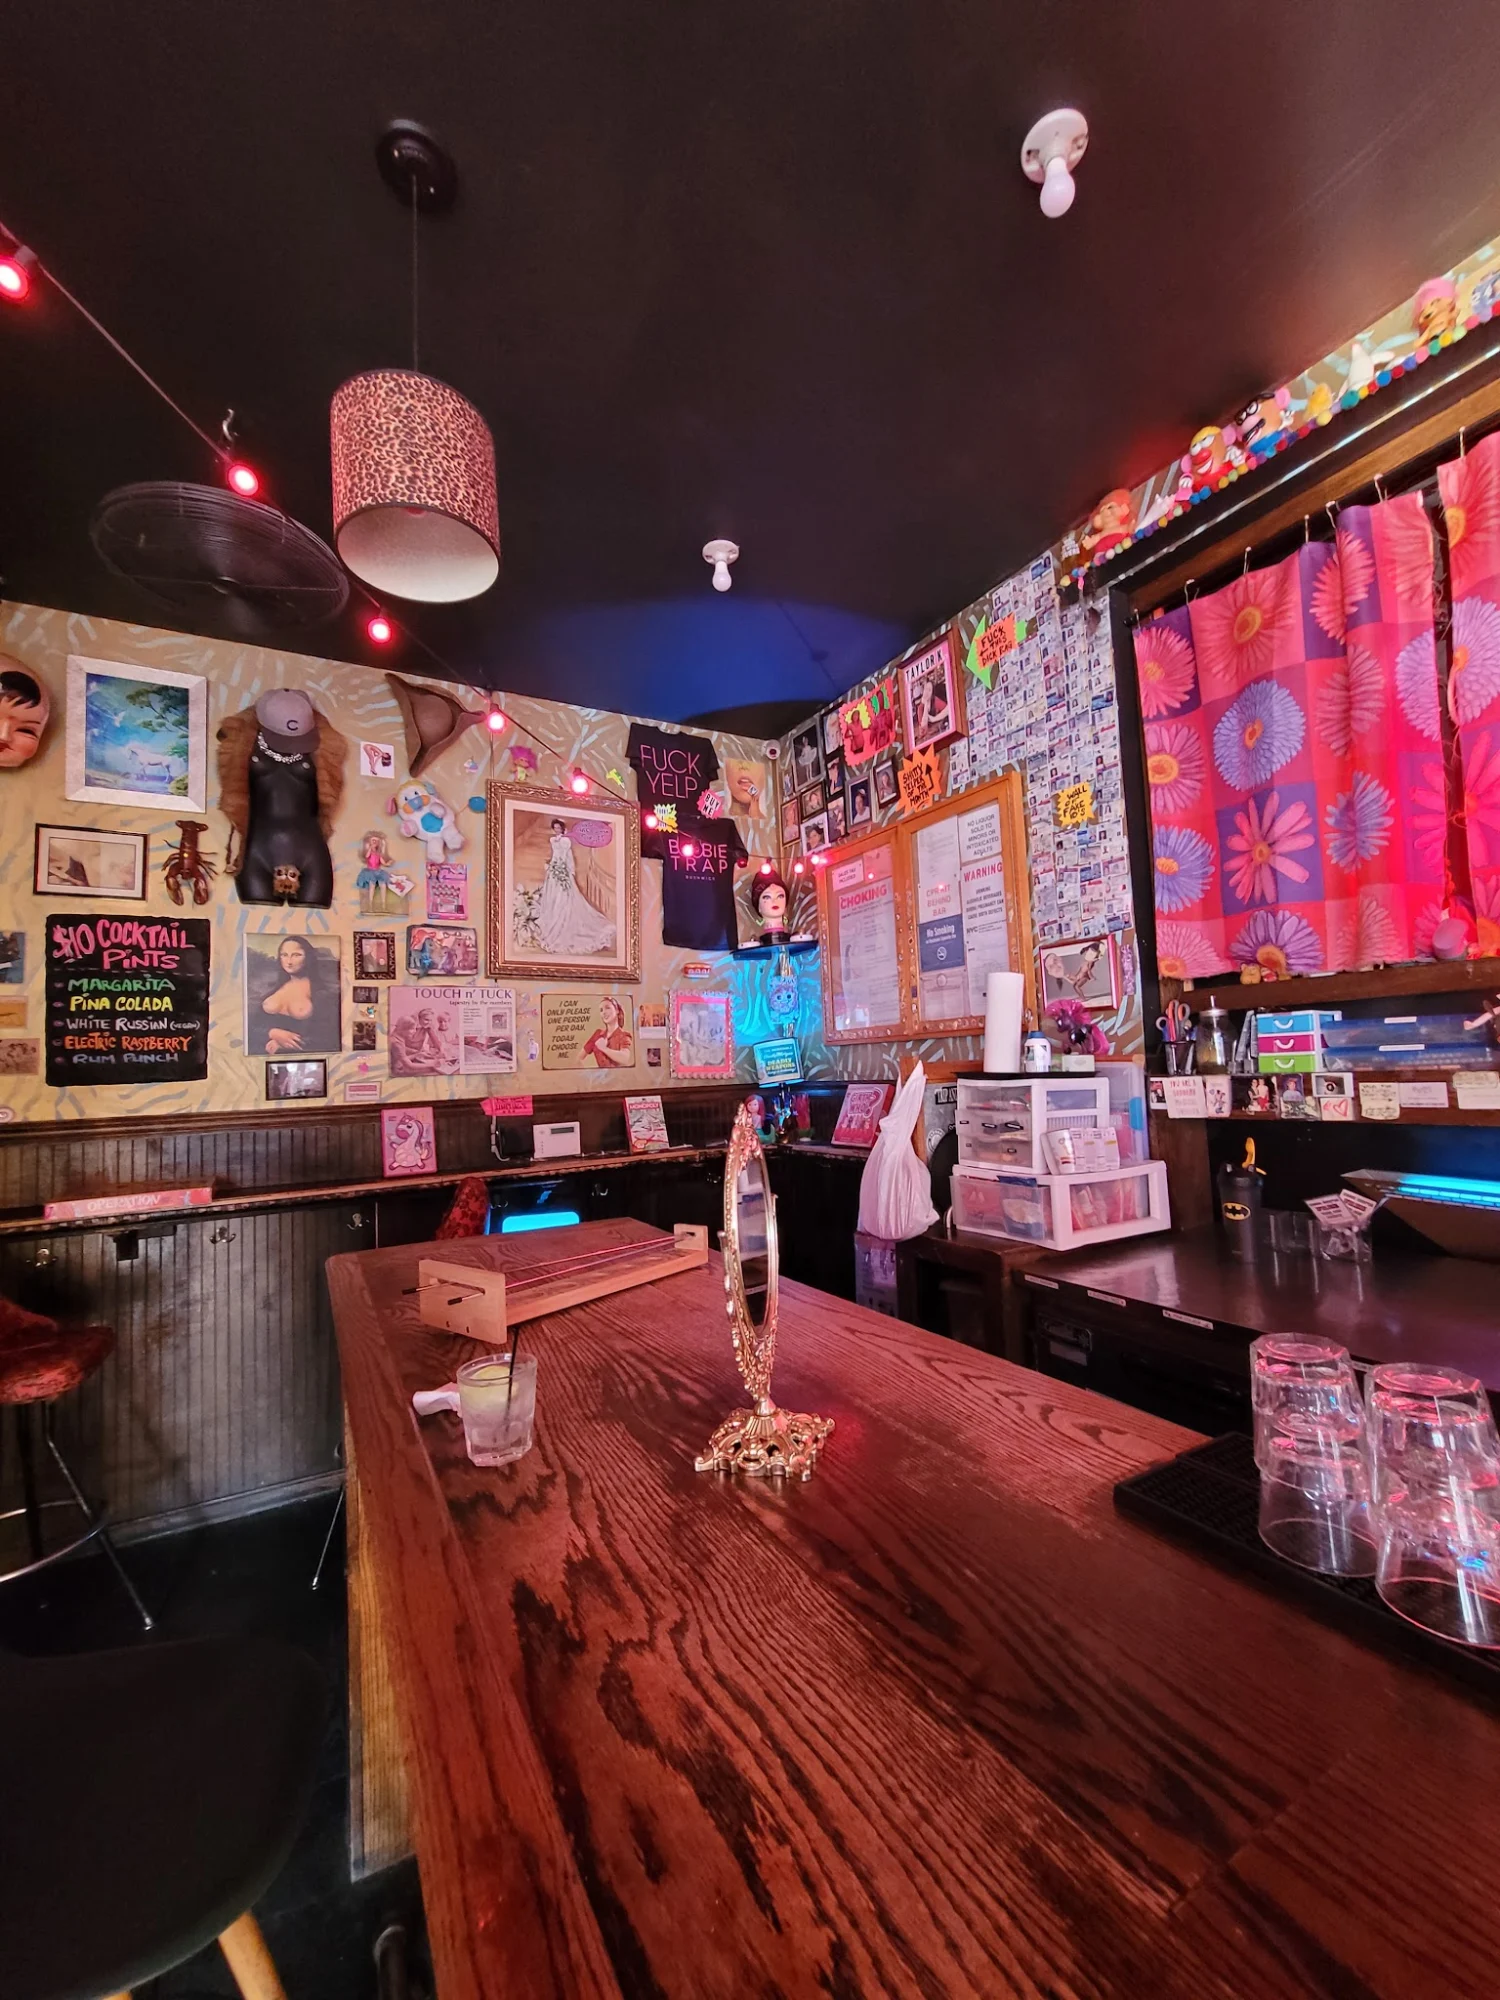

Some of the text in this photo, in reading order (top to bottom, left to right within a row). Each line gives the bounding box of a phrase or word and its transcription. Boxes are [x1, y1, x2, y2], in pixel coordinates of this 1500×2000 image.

[981, 626, 1006, 647] FUCK
[906, 649, 942, 679] TAYLOR K
[287, 719, 299, 731] C
[640, 744, 701, 777] FUCK
[645, 770, 698, 799] YELP
[1067, 785, 1087, 799] WALL
[705, 793, 720, 809] BUY
[702, 803, 714, 817] ME
[1063, 800, 1085, 817] FAKE
[975, 814, 995, 825] LIQUOR
[970, 824, 984, 834] SOLD
[966, 836, 999, 850] INTOXICATED
[968, 832, 987, 842] MINORS
[973, 846, 993, 856] ADULTS
[670, 856, 728, 873] TRAP
[964, 862, 1003, 882] WARNING
[840, 884, 887, 909] CHOKING
[933, 907, 946, 916] BAR
[926, 925, 955, 938] No Smoking
[966, 926, 978, 934] NYC
[413, 988, 461, 999] TOUCH
[480, 988, 512, 999] TUCK
[115, 996, 173, 1012] COLADA
[563, 1016, 590, 1024] PERSON
[122, 1036, 192, 1053] RASPBERRY
[551, 1043, 578, 1051] CHOOSE
[72, 1052, 178, 1064] RUM PUNCH
[629, 1102, 660, 1110] MONOPOLY
[88, 1194, 161, 1211] OPERATION
